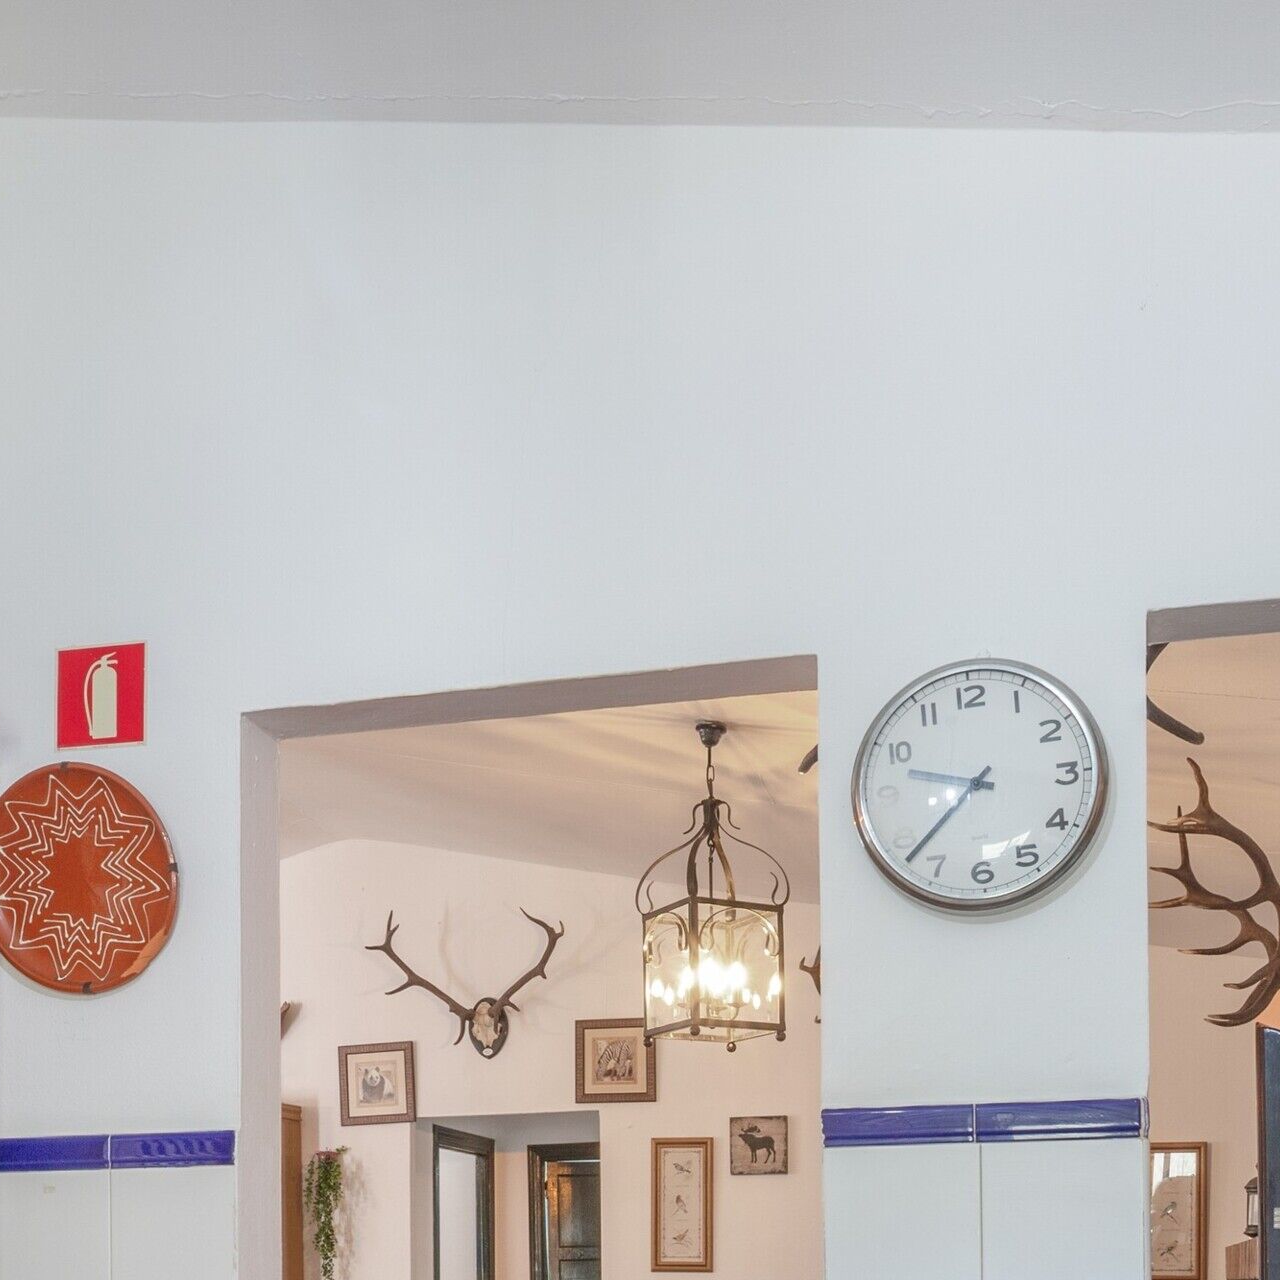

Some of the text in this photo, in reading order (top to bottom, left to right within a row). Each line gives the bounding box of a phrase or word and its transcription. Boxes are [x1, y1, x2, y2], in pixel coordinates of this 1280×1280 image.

[956, 685, 986, 710] 12
[1013, 690, 1020, 713] 1
[920, 702, 938, 727] 11
[1038, 719, 1062, 743] 2
[888, 741, 912, 765] 10
[1054, 761, 1079, 785] 3
[1045, 808, 1069, 830] 4
[926, 855, 947, 878] 7
[1015, 844, 1039, 867] 5
[970, 861, 995, 885] 6
